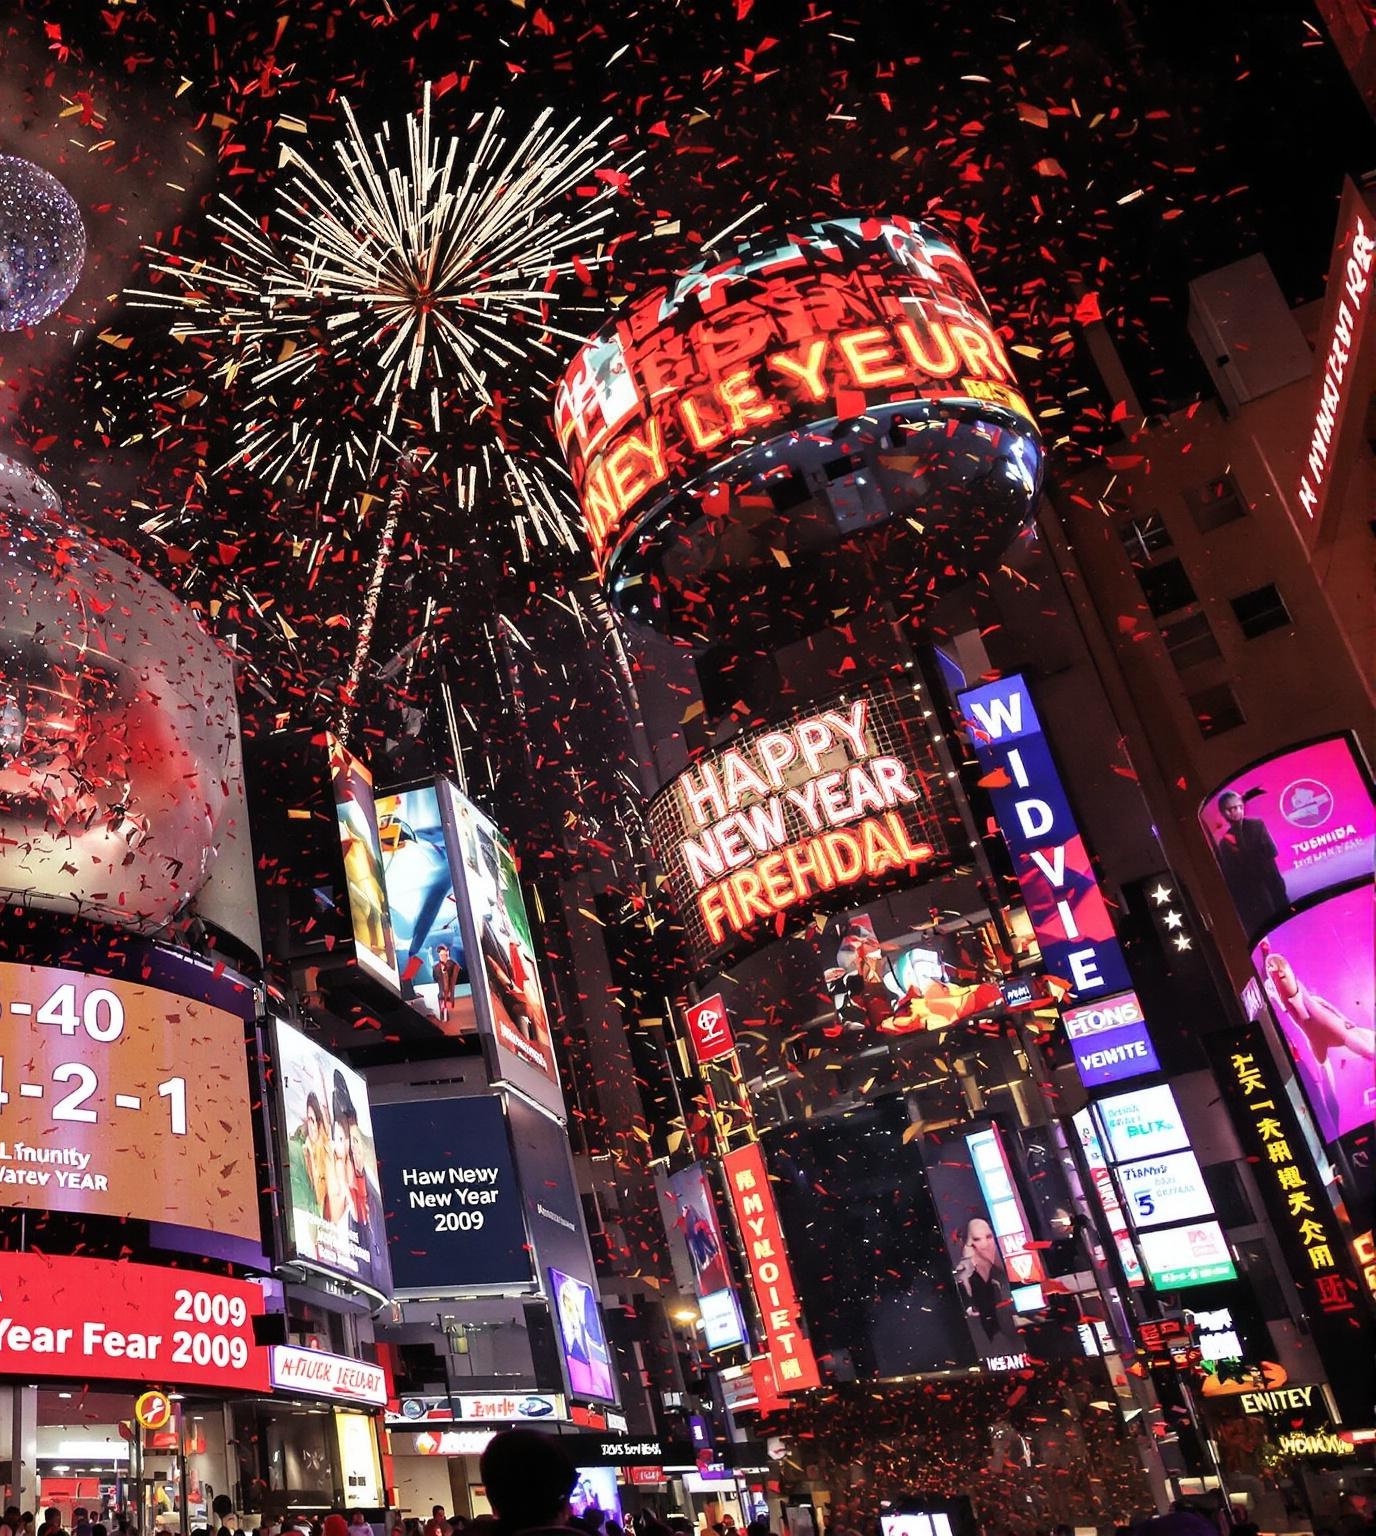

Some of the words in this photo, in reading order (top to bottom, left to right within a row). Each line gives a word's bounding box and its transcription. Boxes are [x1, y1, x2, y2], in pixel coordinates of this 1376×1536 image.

[682, 699, 867, 825] HAPPY
[683, 795, 787, 888] NEW
[787, 756, 920, 831] YEAR
[54, 1170, 108, 1191] YEAR
[403, 1169, 445, 1186] Haw
[409, 1191, 452, 1208] New
[454, 1188, 499, 1205] Year
[434, 1211, 484, 1231] 2009
[174, 1289, 247, 1328] 2009
[82, 1322, 162, 1360] Fear
[171, 1331, 248, 1369] 2009
